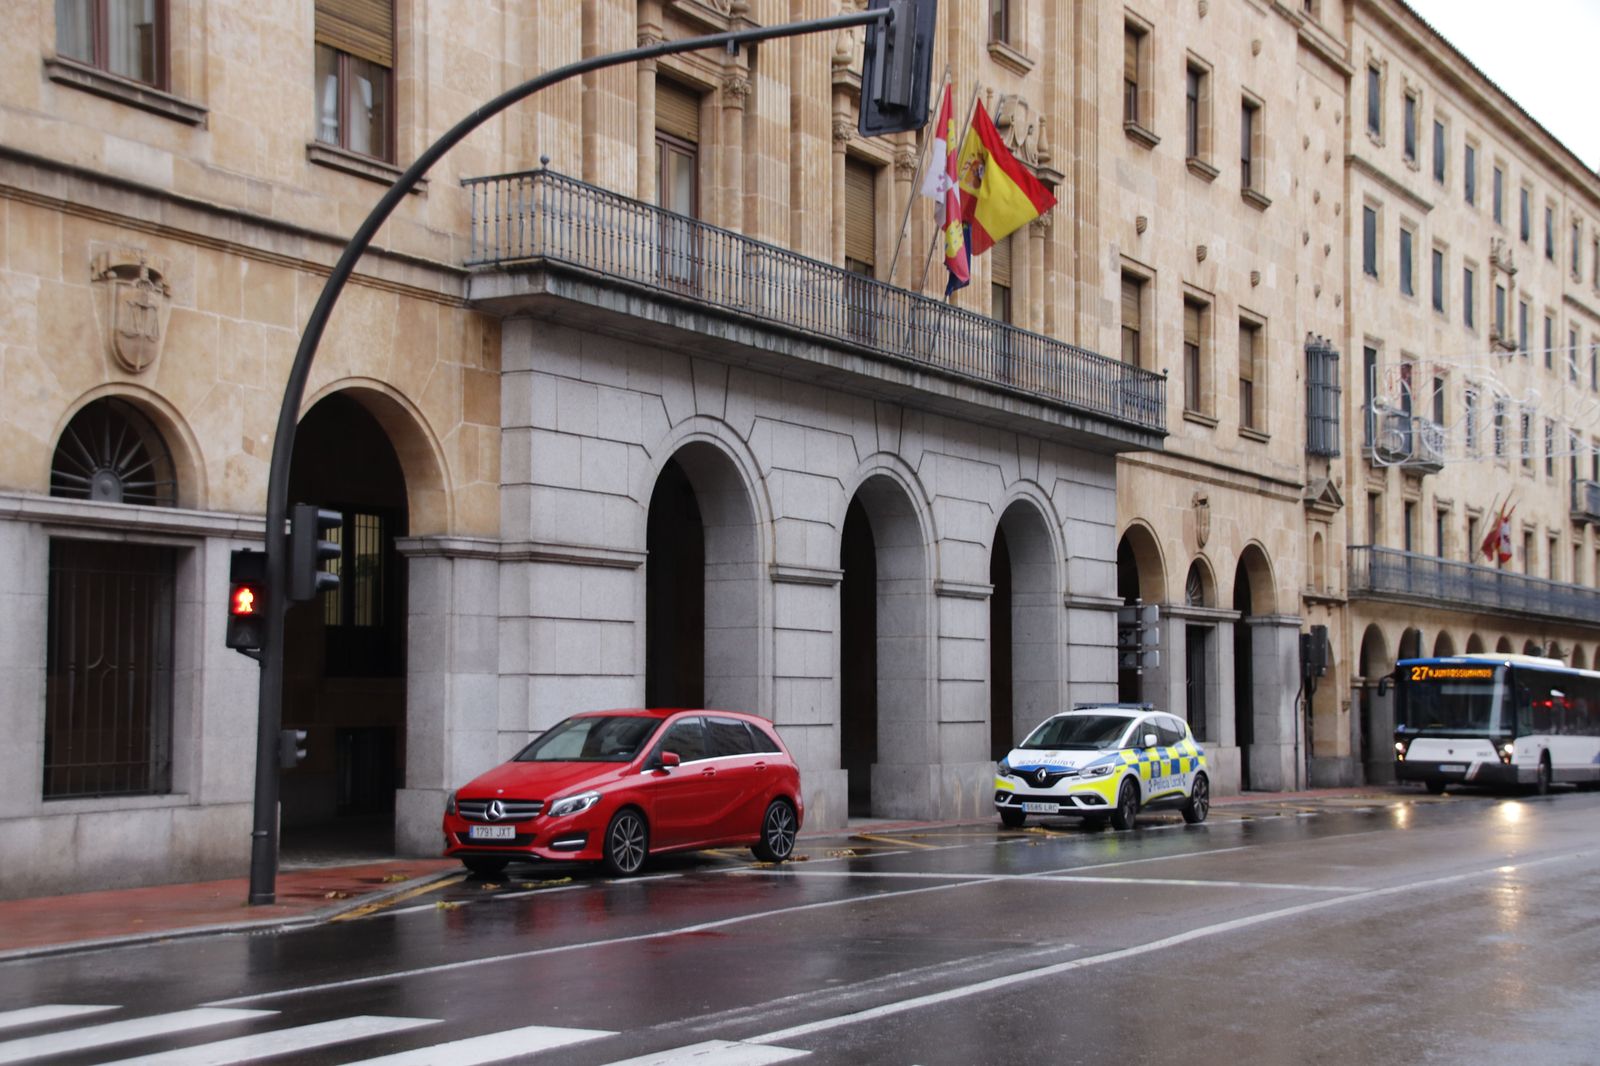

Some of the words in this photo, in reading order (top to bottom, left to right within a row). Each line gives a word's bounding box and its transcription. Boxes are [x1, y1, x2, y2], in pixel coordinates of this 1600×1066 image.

[1411, 666, 1429, 680] 27
[476, 827, 493, 837] 1791
[496, 827, 511, 838] JXT
